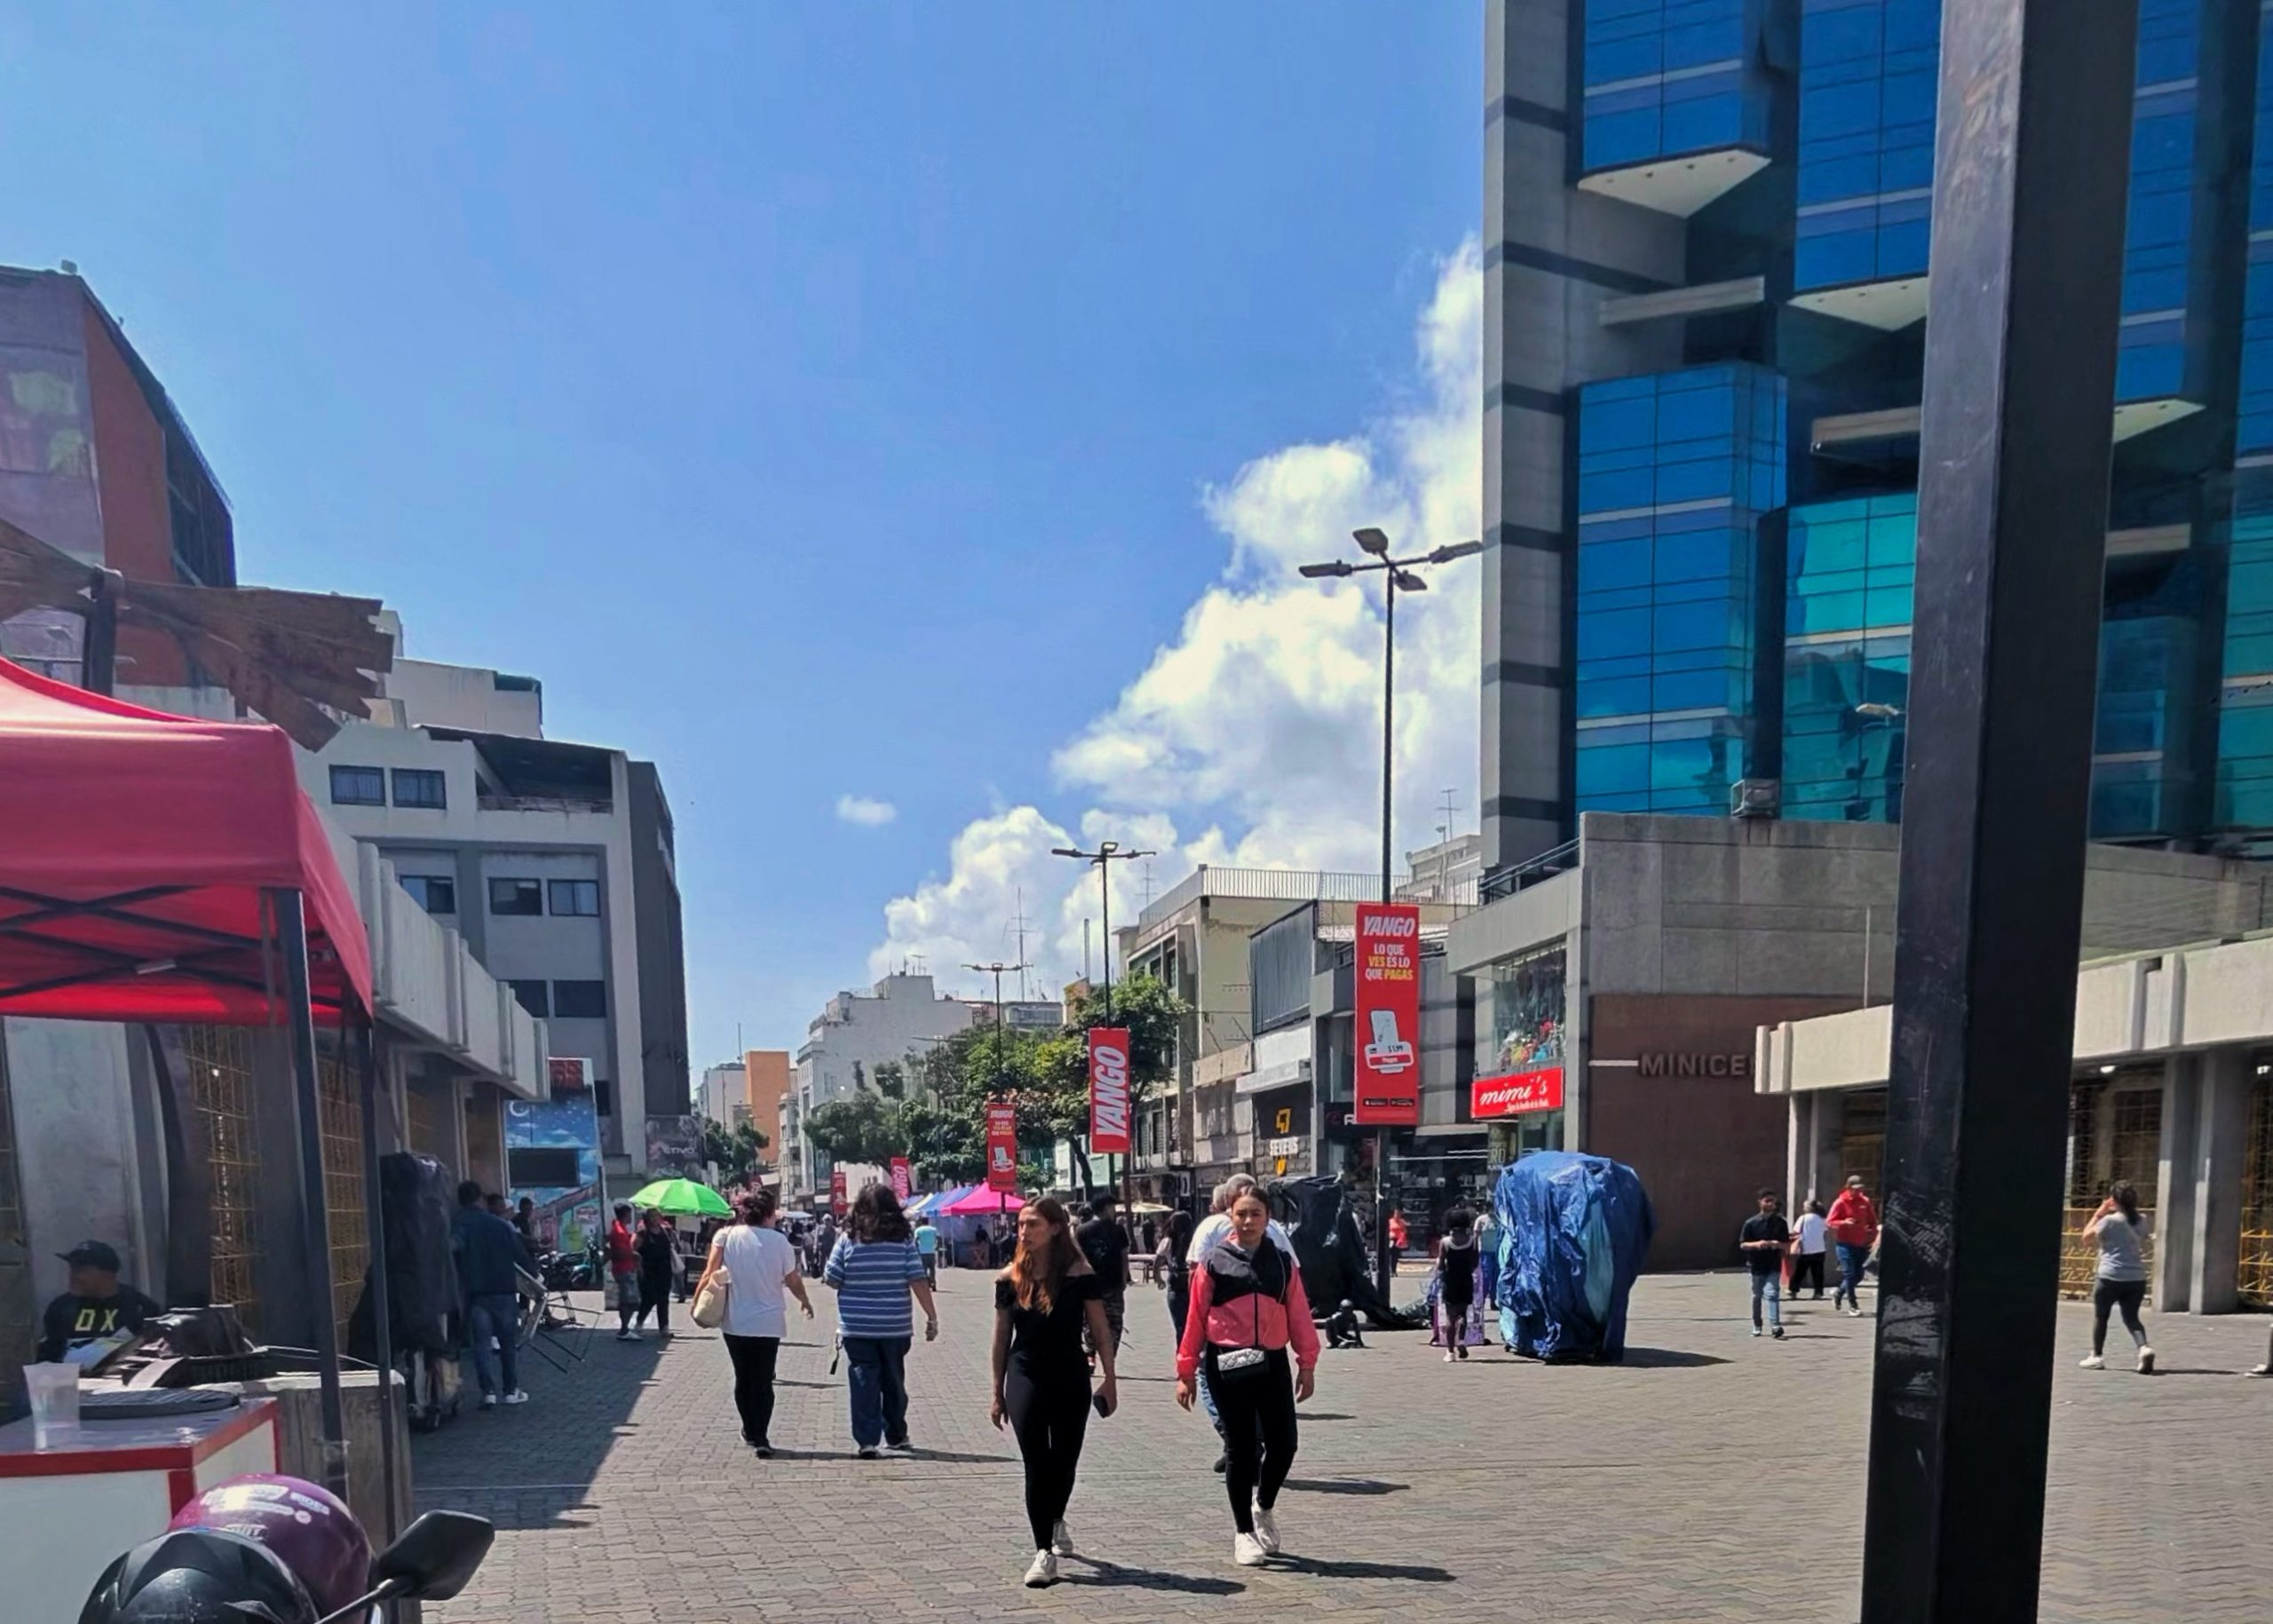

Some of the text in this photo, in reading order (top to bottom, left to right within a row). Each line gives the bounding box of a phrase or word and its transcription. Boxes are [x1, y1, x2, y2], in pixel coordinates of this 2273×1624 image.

[1363, 915, 1415, 938] YANGO
[1374, 943, 1405, 956] LO QUE
[1368, 955, 1410, 969] VES ES LO
[1365, 968, 1414, 981] QUE PAGAS
[1094, 1046, 1127, 1138] YANGO
[1479, 1075, 1548, 1106] mimi's
